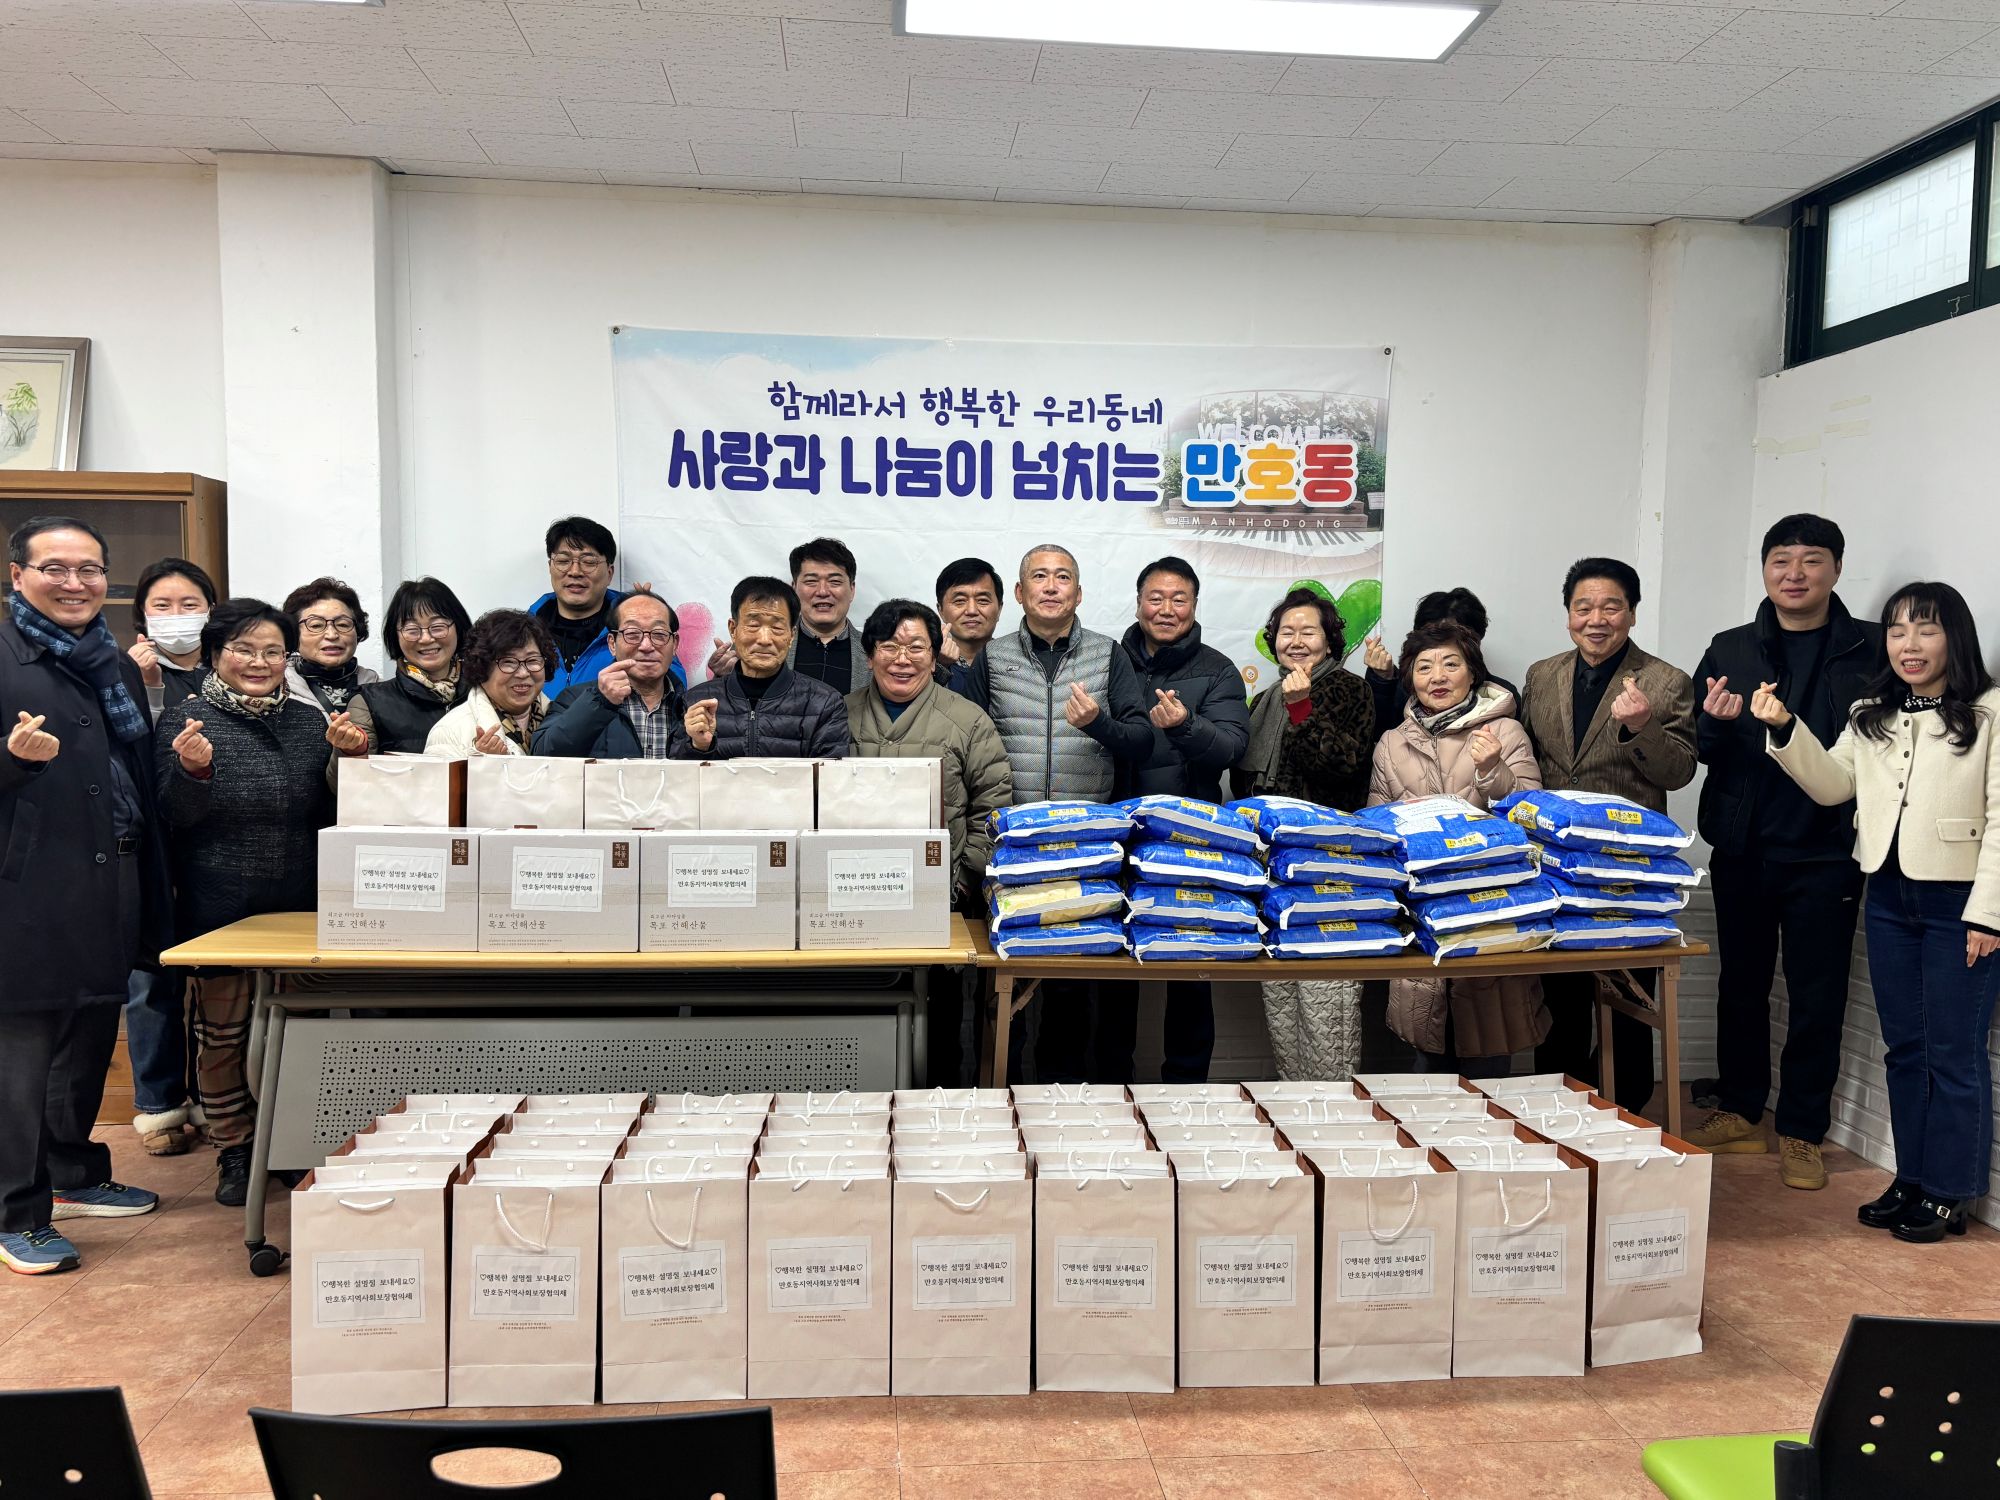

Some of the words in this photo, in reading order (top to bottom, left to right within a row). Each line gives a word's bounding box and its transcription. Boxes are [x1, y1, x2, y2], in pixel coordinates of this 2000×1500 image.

[767, 380, 906, 421] 함께라서
[919, 386, 1021, 429] 행복한
[1033, 392, 1163, 432] 우리동네
[668, 428, 827, 495] 사랑과
[841, 435, 993, 500] 나눔이
[1012, 440, 1161, 502] 넘치는
[1184, 442, 1356, 504] 만호동
[1191, 517, 1342, 529] MANHODONG
[328, 920, 345, 928] 목포
[488, 921, 506, 929] 목포
[650, 921, 667, 929] 목포
[810, 920, 826, 928] 목포
[1618, 1240, 1634, 1248] 행복한
[1656, 1235, 1677, 1244] 보내세요
[1396, 1255, 1421, 1263] 보내세요
[1483, 1253, 1501, 1261] 행복한
[1527, 1251, 1552, 1259] 보내세요
[782, 1266, 802, 1274] 행복한
[829, 1264, 856, 1272] 보내세요
[928, 1263, 947, 1271] 행복한
[974, 1262, 1001, 1270] 보내세요
[1256, 1262, 1283, 1270] 보내세요
[536, 1274, 564, 1282] 보내세요
[635, 1274, 654, 1282] 행복한
[683, 1269, 710, 1278] 보내세요
[329, 1279, 350, 1288] 행복한
